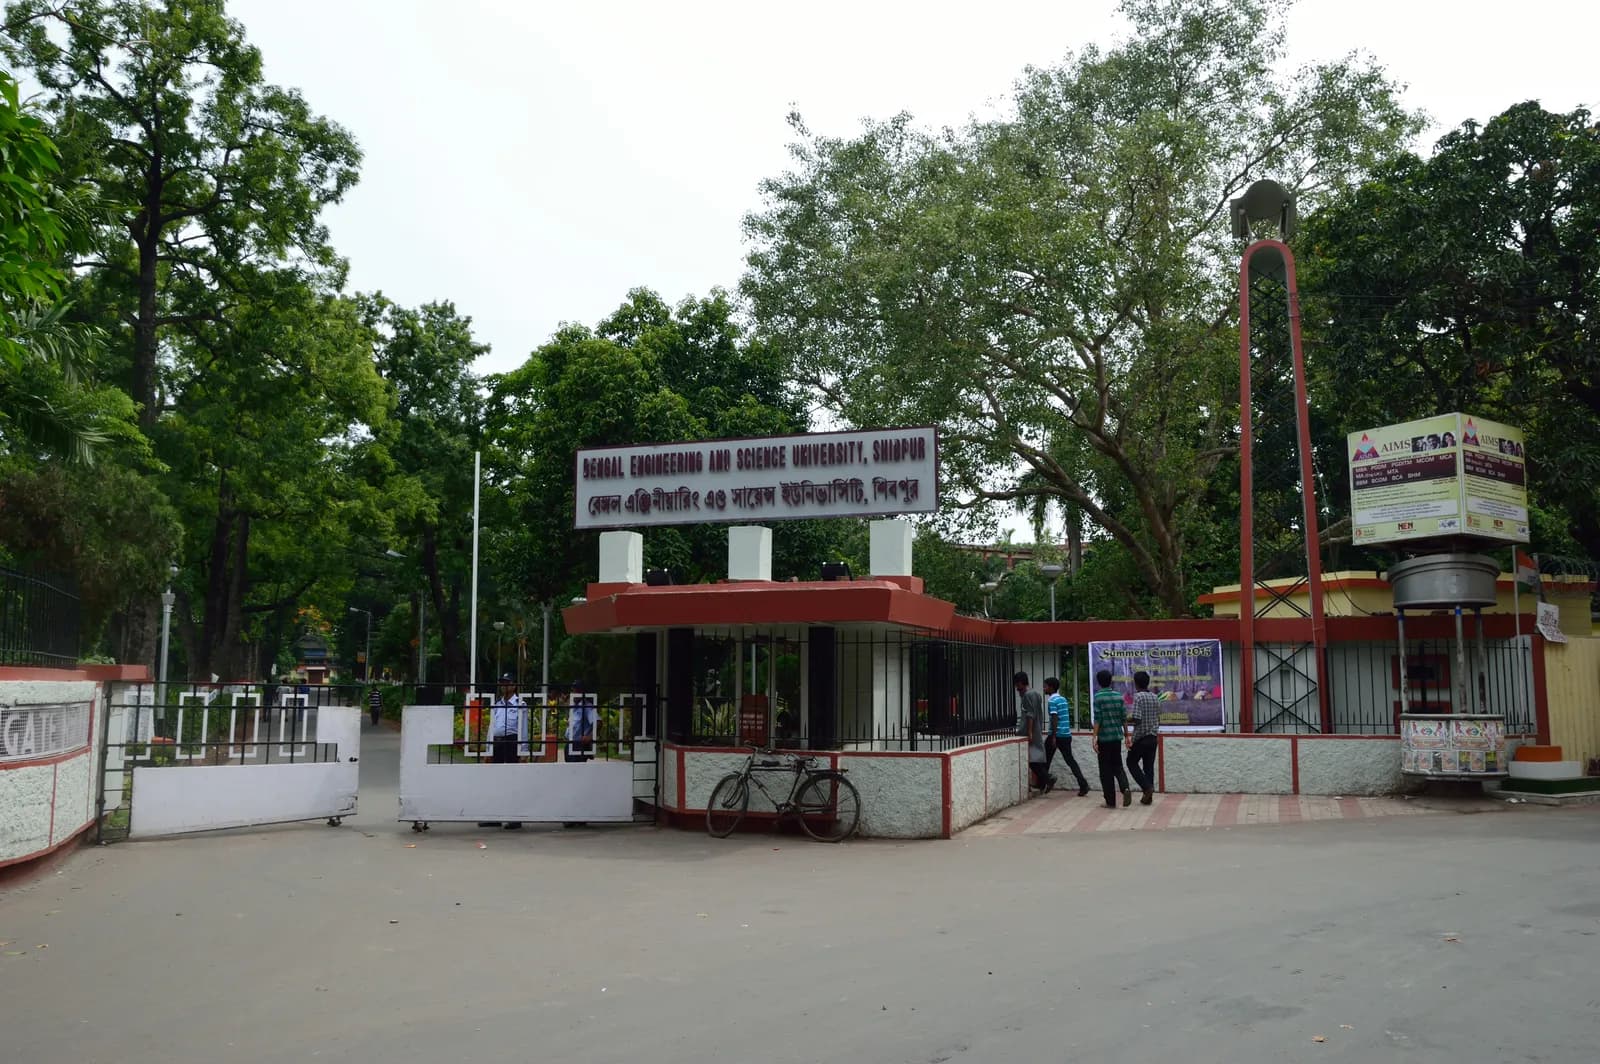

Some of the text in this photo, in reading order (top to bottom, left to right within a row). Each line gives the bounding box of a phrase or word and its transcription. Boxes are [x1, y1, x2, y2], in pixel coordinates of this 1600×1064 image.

[583, 437, 926, 479] BENGAL ENGINEERING AND SCIENCE UNIVERSITY, SHIBPUR
[1380, 439, 1411, 453] AIMS
[872, 476, 920, 504] শিবপুর
[1099, 646, 1212, 660] Summer Camp 2015
[3, 711, 58, 756] GATE
